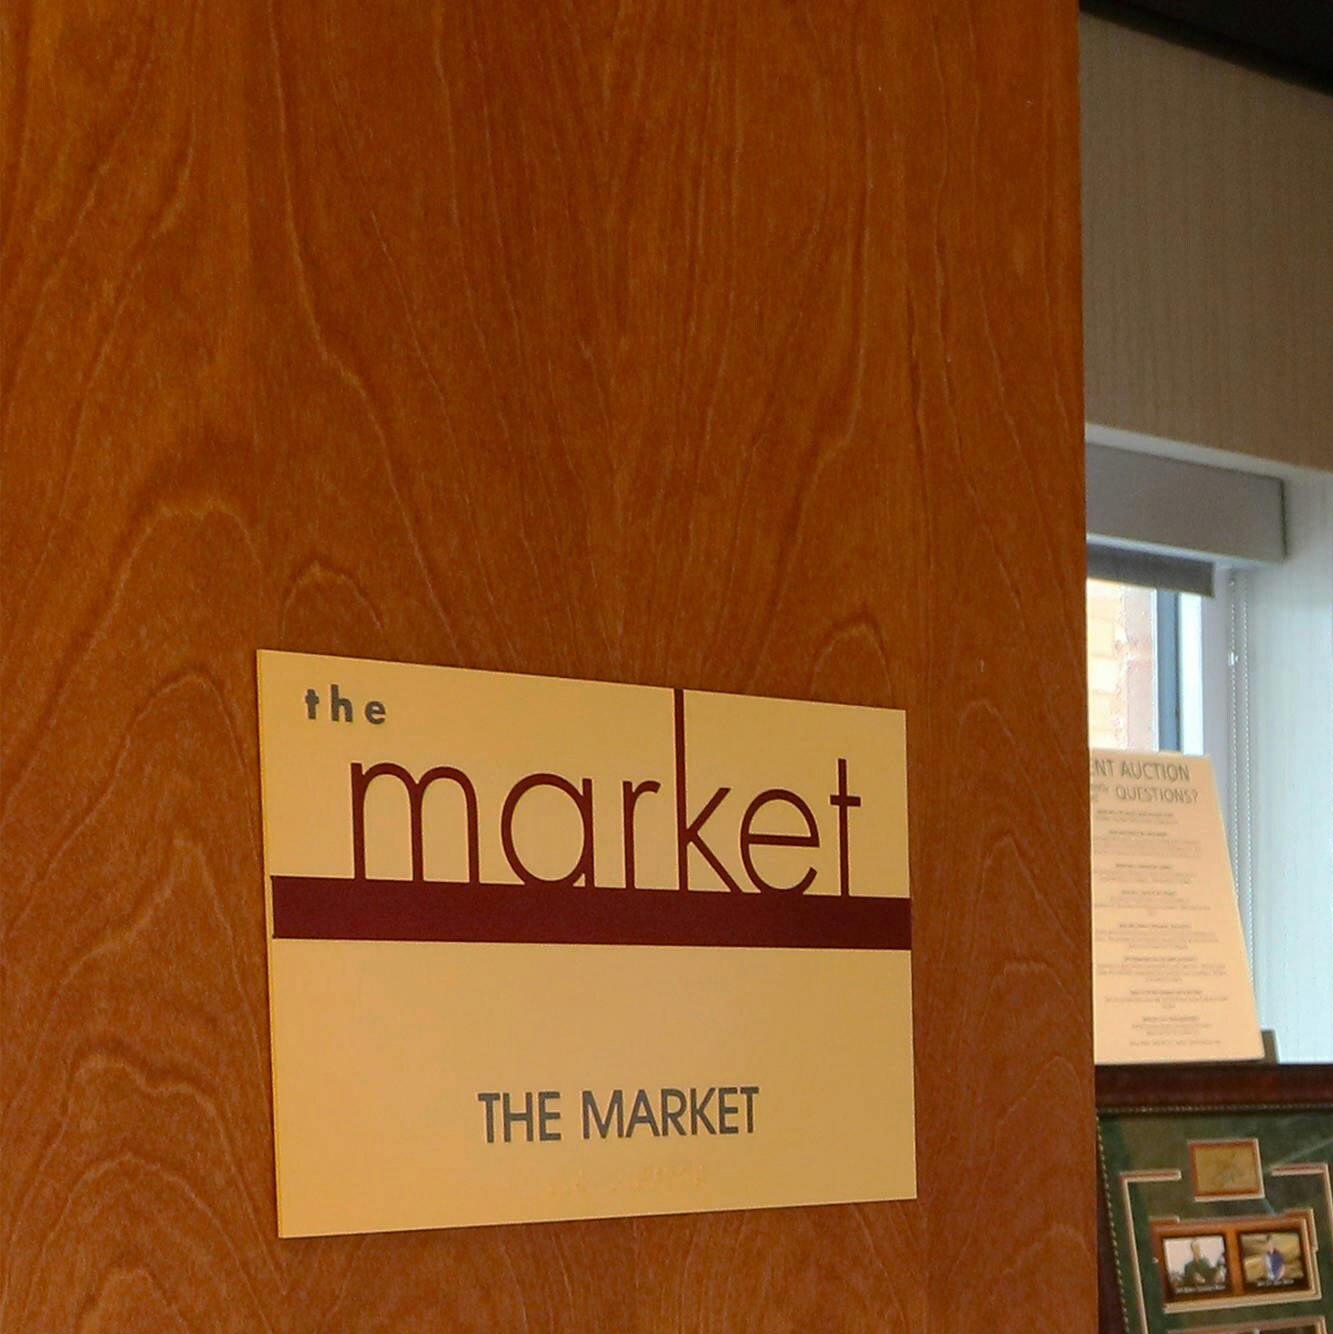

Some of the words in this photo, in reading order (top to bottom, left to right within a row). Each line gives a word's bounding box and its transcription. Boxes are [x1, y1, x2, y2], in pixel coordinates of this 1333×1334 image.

[304, 685, 388, 725] the
[350, 687, 862, 897] market
[1090, 757, 1115, 777] NT
[1120, 760, 1191, 783] AUCTION
[477, 1090, 562, 1144] THE
[581, 1086, 760, 1139] MARKET
